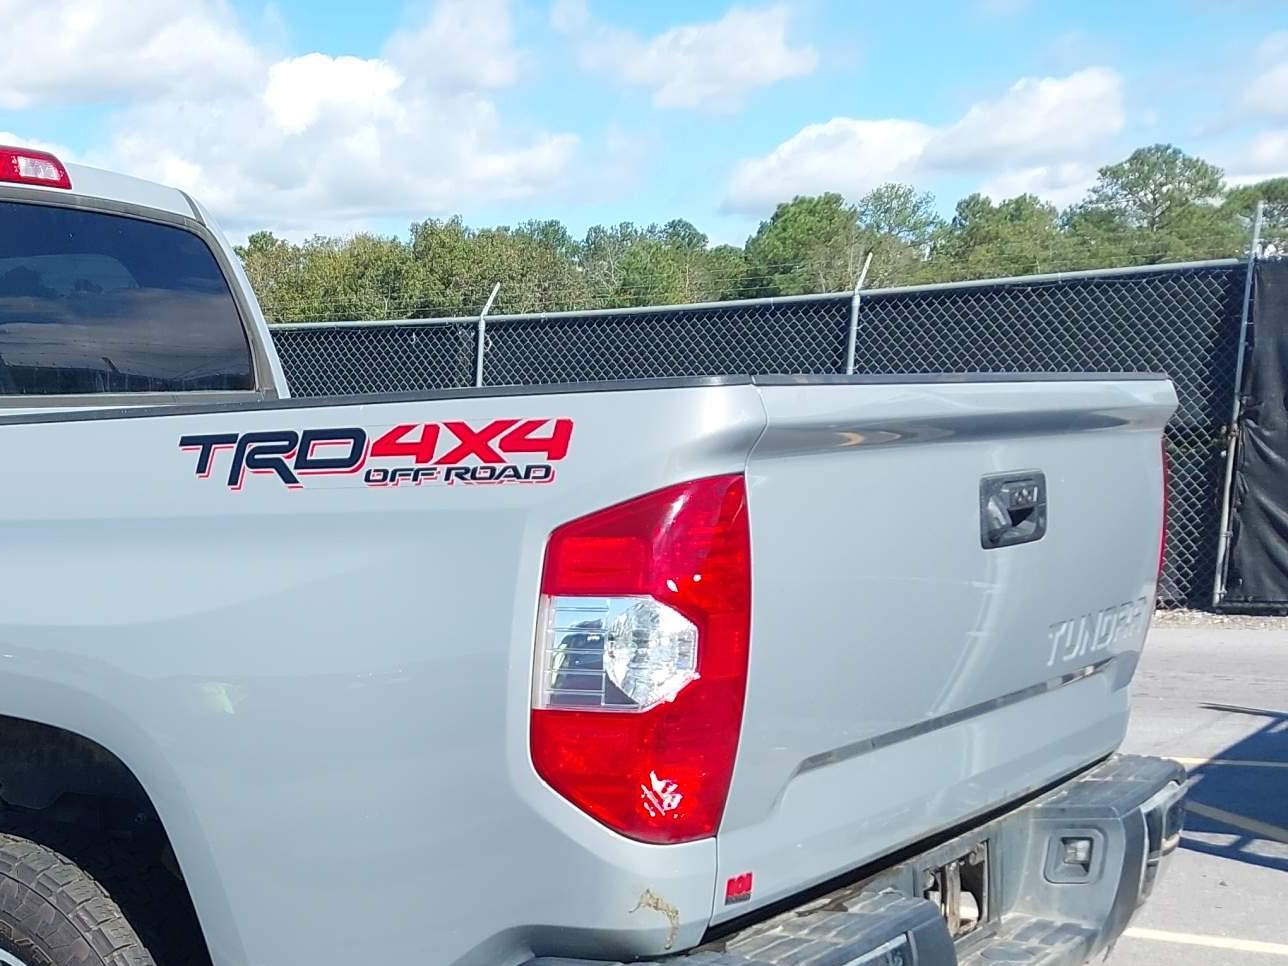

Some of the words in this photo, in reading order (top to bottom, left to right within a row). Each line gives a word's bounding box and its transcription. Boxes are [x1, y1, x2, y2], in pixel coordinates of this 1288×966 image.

[179, 428, 369, 490] TRD
[370, 418, 574, 467] 4X4
[363, 466, 441, 487] OFF
[443, 463, 557, 487] ROAD
